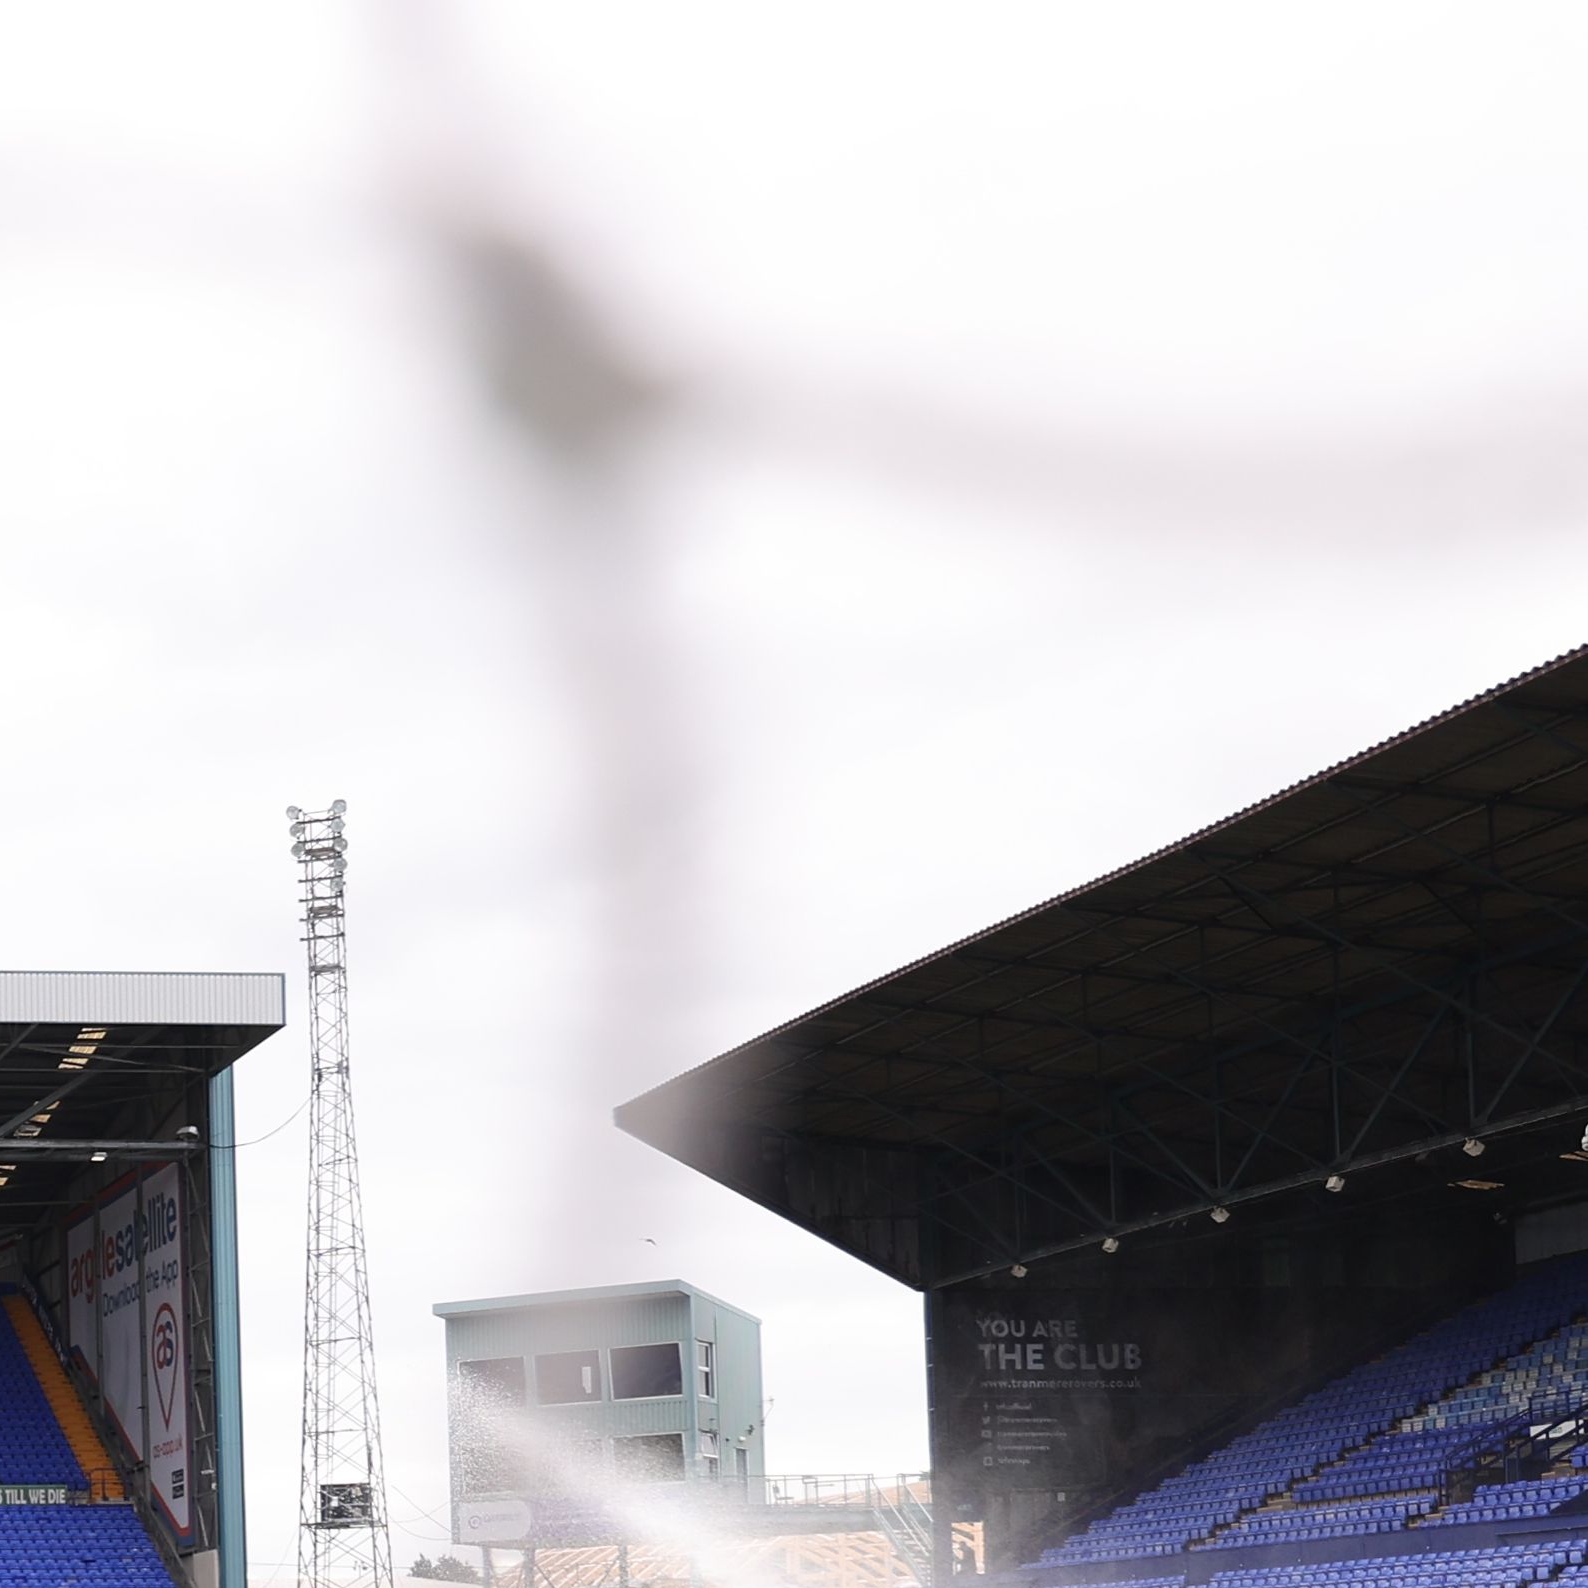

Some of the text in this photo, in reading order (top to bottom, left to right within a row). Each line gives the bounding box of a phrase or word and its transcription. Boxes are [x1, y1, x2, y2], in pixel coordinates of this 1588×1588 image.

[976, 1320, 1079, 1338] YOU ARE
[978, 1344, 1142, 1370] THE CLUB
[980, 1376, 1142, 1389] www.tranmererovers.co.uk
[4, 1488, 28, 1504] TILL
[29, 1488, 45, 1504] WE
[47, 1488, 66, 1504] DIE
